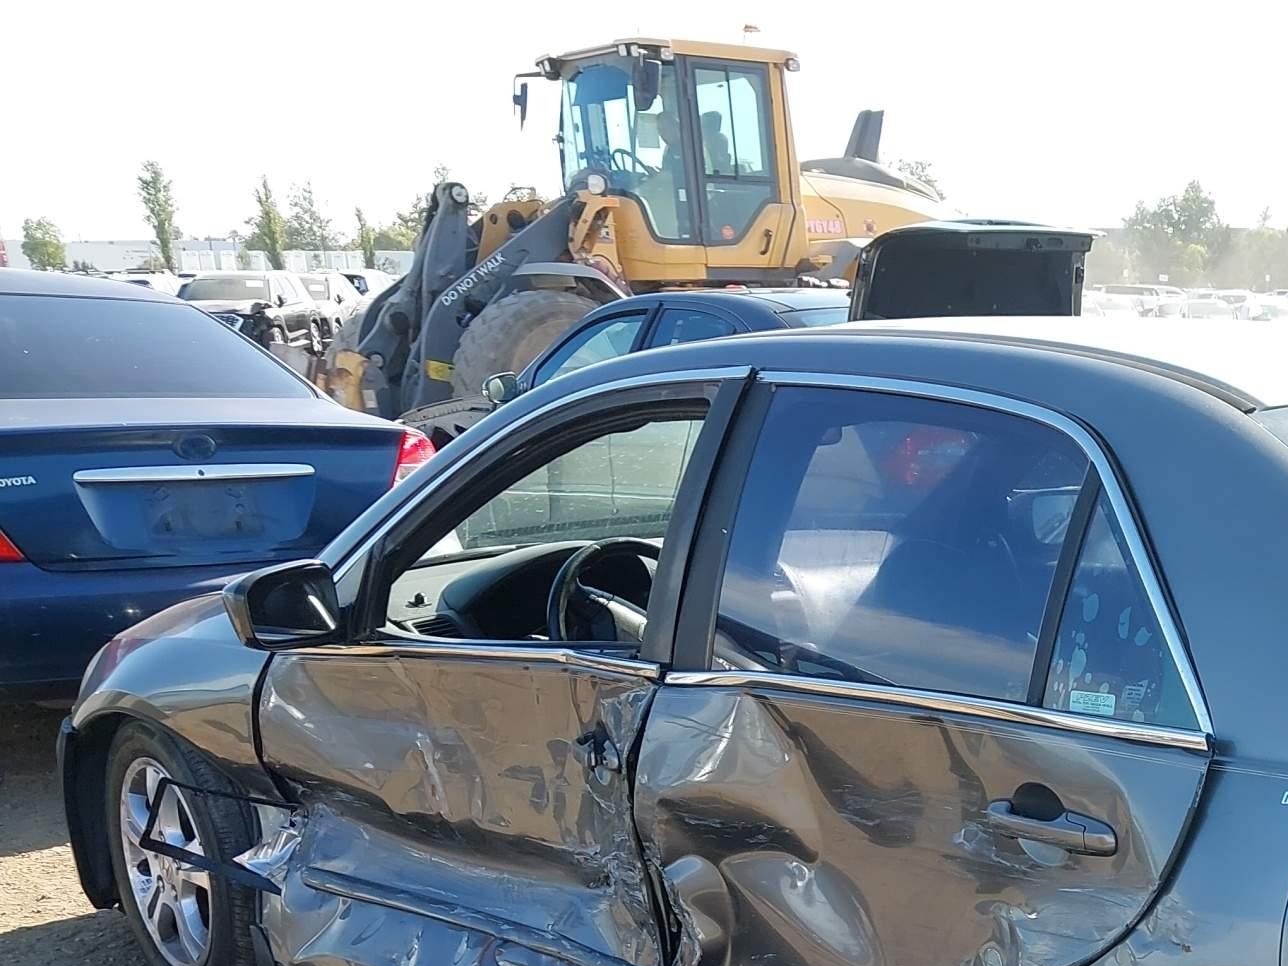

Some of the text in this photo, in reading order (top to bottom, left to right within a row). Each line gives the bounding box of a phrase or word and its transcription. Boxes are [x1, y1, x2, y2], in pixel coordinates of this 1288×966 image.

[441, 252, 506, 306] DO NOT WALK
